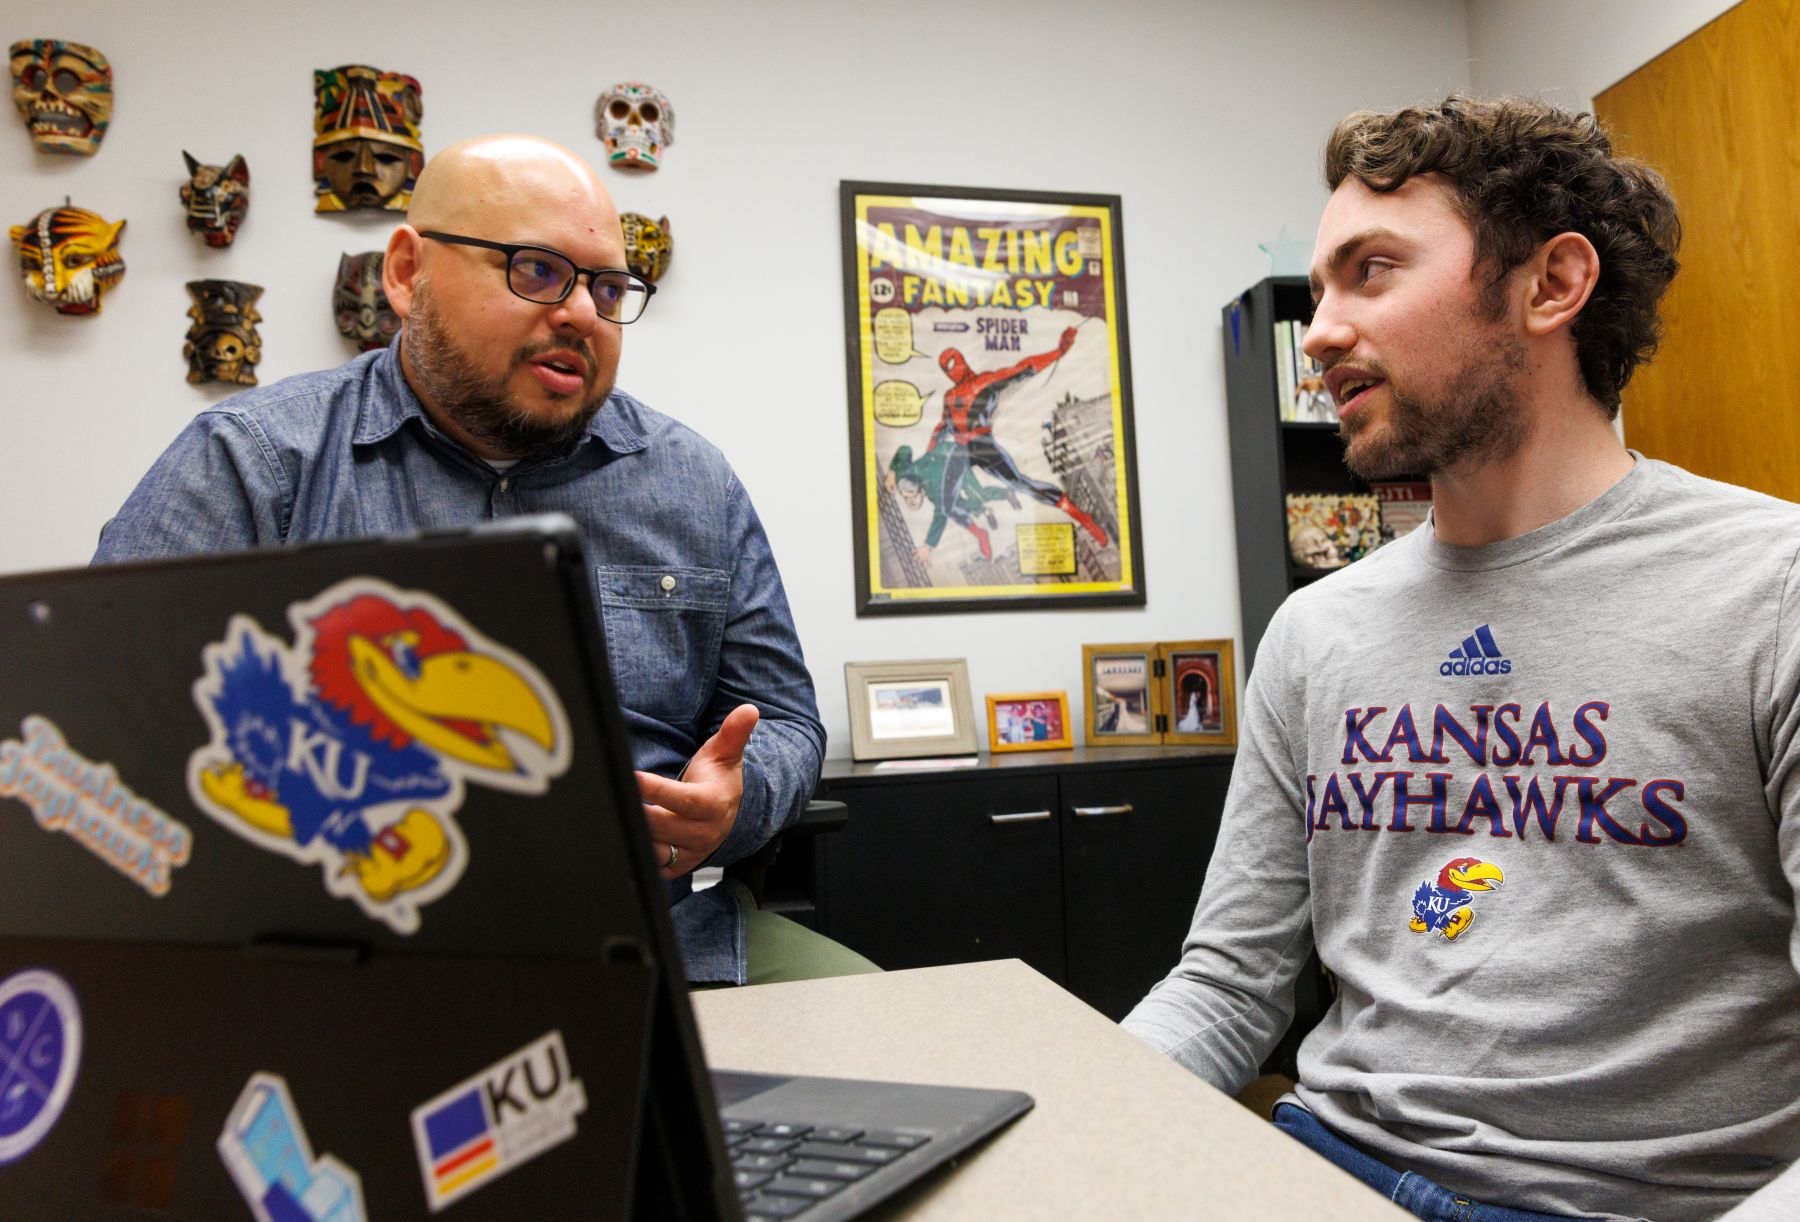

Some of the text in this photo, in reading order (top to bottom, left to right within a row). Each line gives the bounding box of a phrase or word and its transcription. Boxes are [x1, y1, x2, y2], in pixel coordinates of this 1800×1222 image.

[871, 223, 1084, 278] AMAZING
[903, 275, 1055, 308] FANTASY
[976, 318, 1028, 334] SPIDER
[985, 335, 1020, 351] MAN
[1440, 656, 1512, 676] adidas
[1341, 701, 1610, 767] KANSAS
[288, 718, 372, 800] KU
[1306, 771, 1688, 848] JAYHAWKS
[1427, 895, 1450, 914] KU
[486, 1044, 561, 1127] KU
